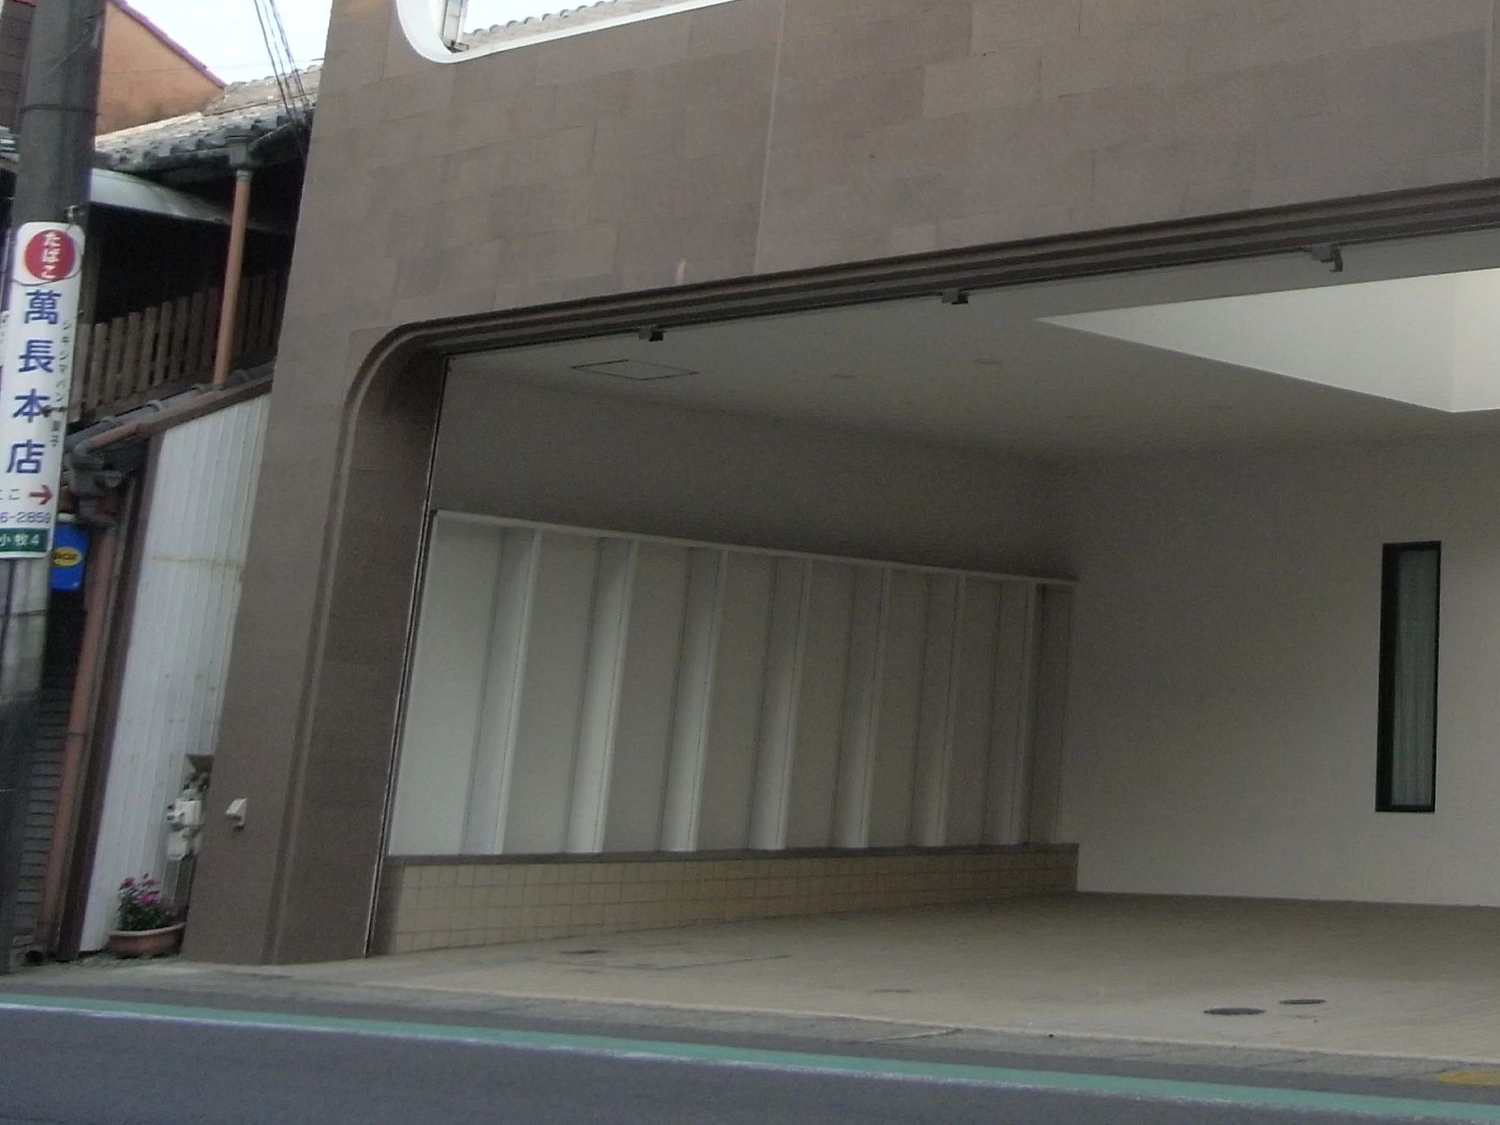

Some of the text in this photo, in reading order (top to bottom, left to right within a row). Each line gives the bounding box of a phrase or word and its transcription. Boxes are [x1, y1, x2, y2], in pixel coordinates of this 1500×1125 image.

[40, 231, 61, 279] たばこ
[6, 289, 62, 474] 萬長本店
